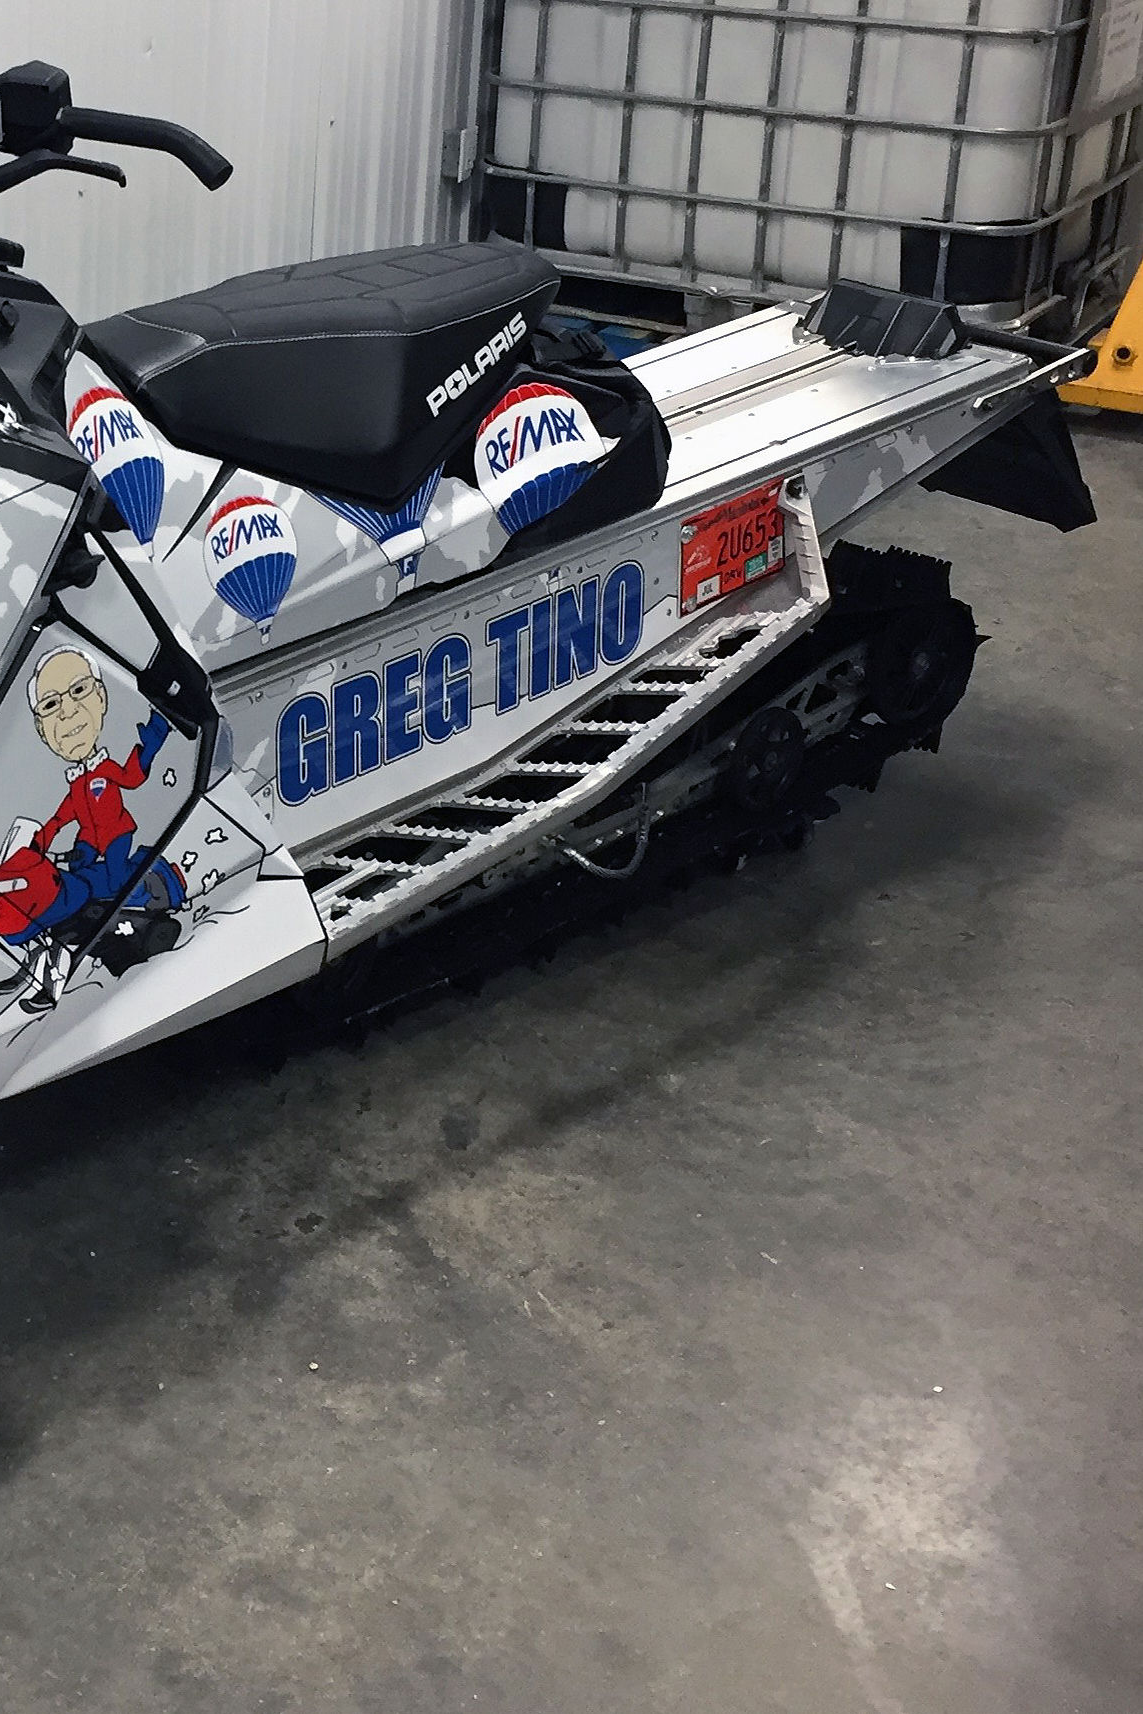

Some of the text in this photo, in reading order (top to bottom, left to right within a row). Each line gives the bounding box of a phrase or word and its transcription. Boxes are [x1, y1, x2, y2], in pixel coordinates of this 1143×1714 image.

[425, 311, 528, 418] POLARIS
[485, 407, 585, 480] RE/MAX
[210, 513, 284, 564] RE/MAX
[276, 559, 646, 807] GREG TINO
